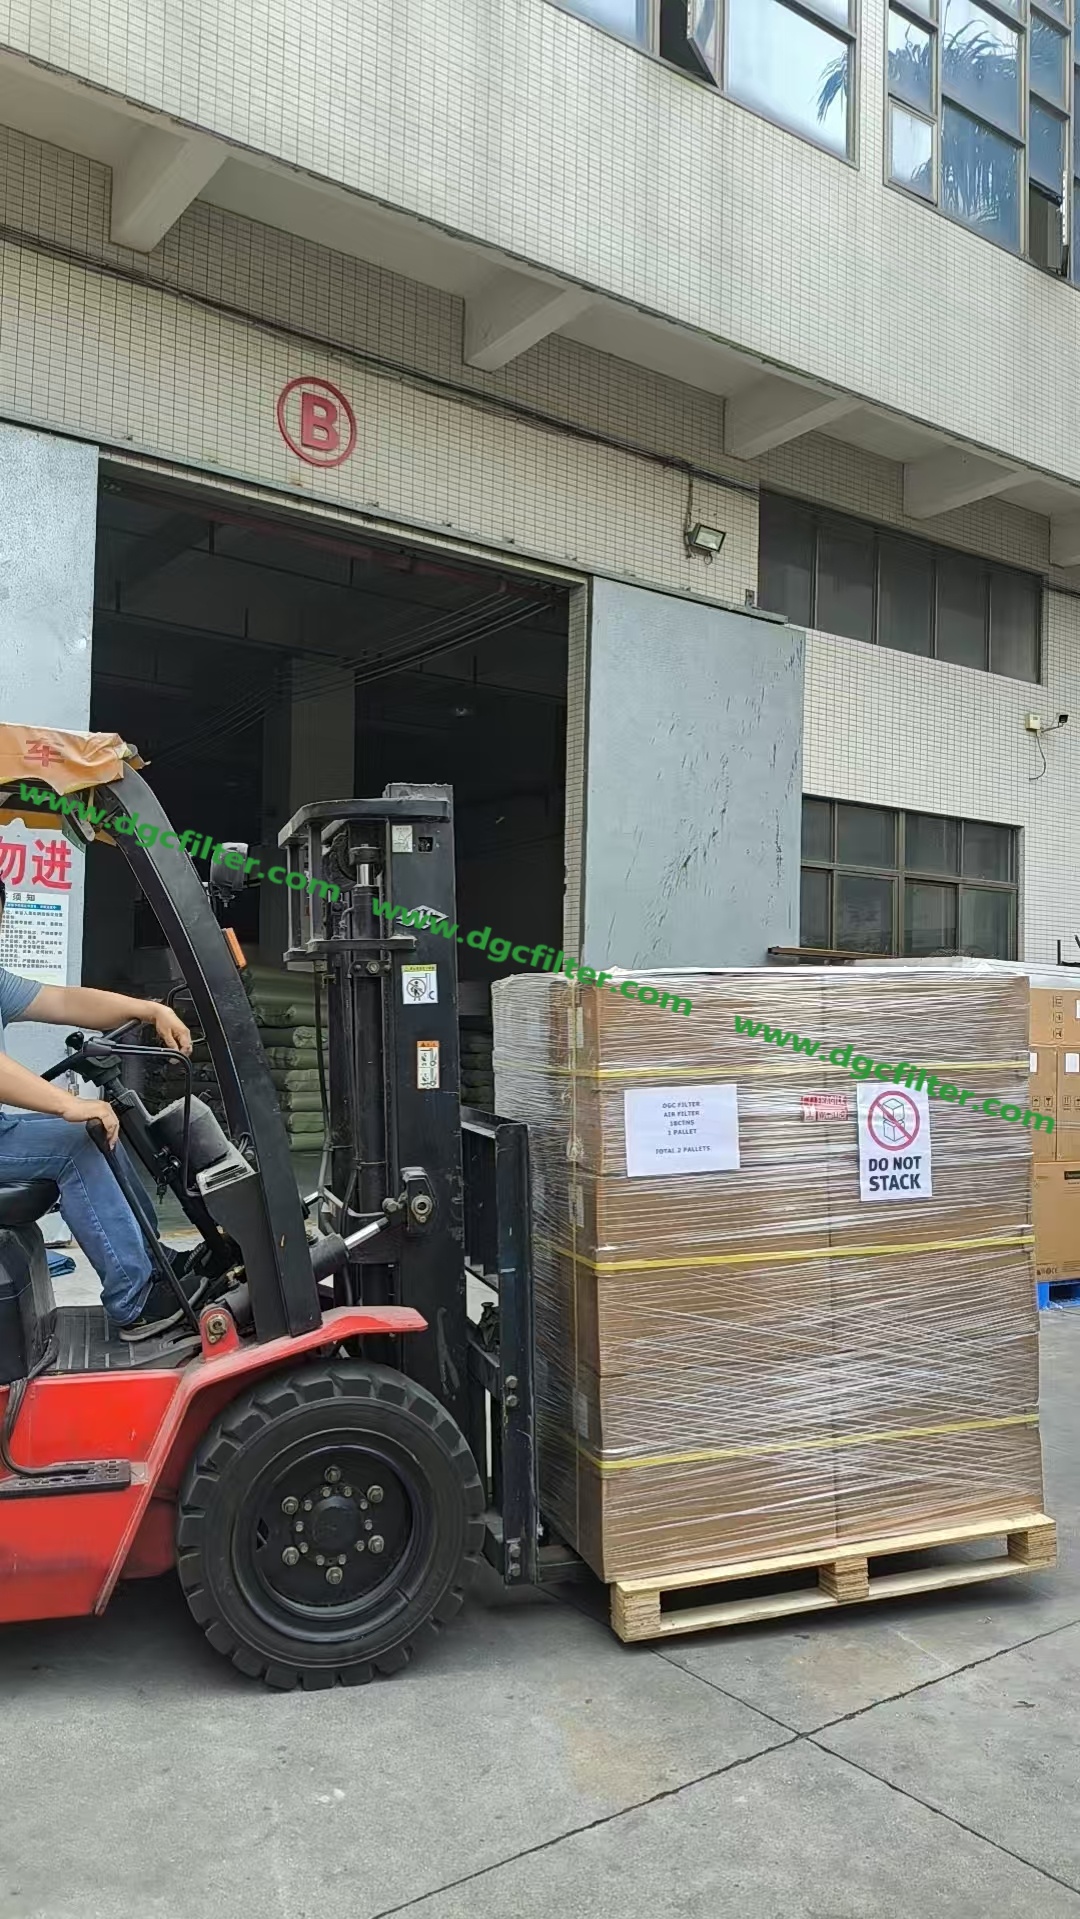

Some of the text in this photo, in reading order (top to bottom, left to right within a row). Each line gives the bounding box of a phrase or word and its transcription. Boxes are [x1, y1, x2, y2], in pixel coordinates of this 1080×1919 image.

[301, 391, 339, 452] B
[23, 738, 65, 768] 车
[0, 836, 72, 889] 勿进
[5, 892, 35, 902] 须知
[673, 1128, 697, 1136] PALLET
[655, 1147, 675, 1155] TOTAL
[683, 1145, 711, 1153] PALLETS
[868, 1155, 922, 1172] DO NOT
[869, 1173, 921, 1192] STACK
